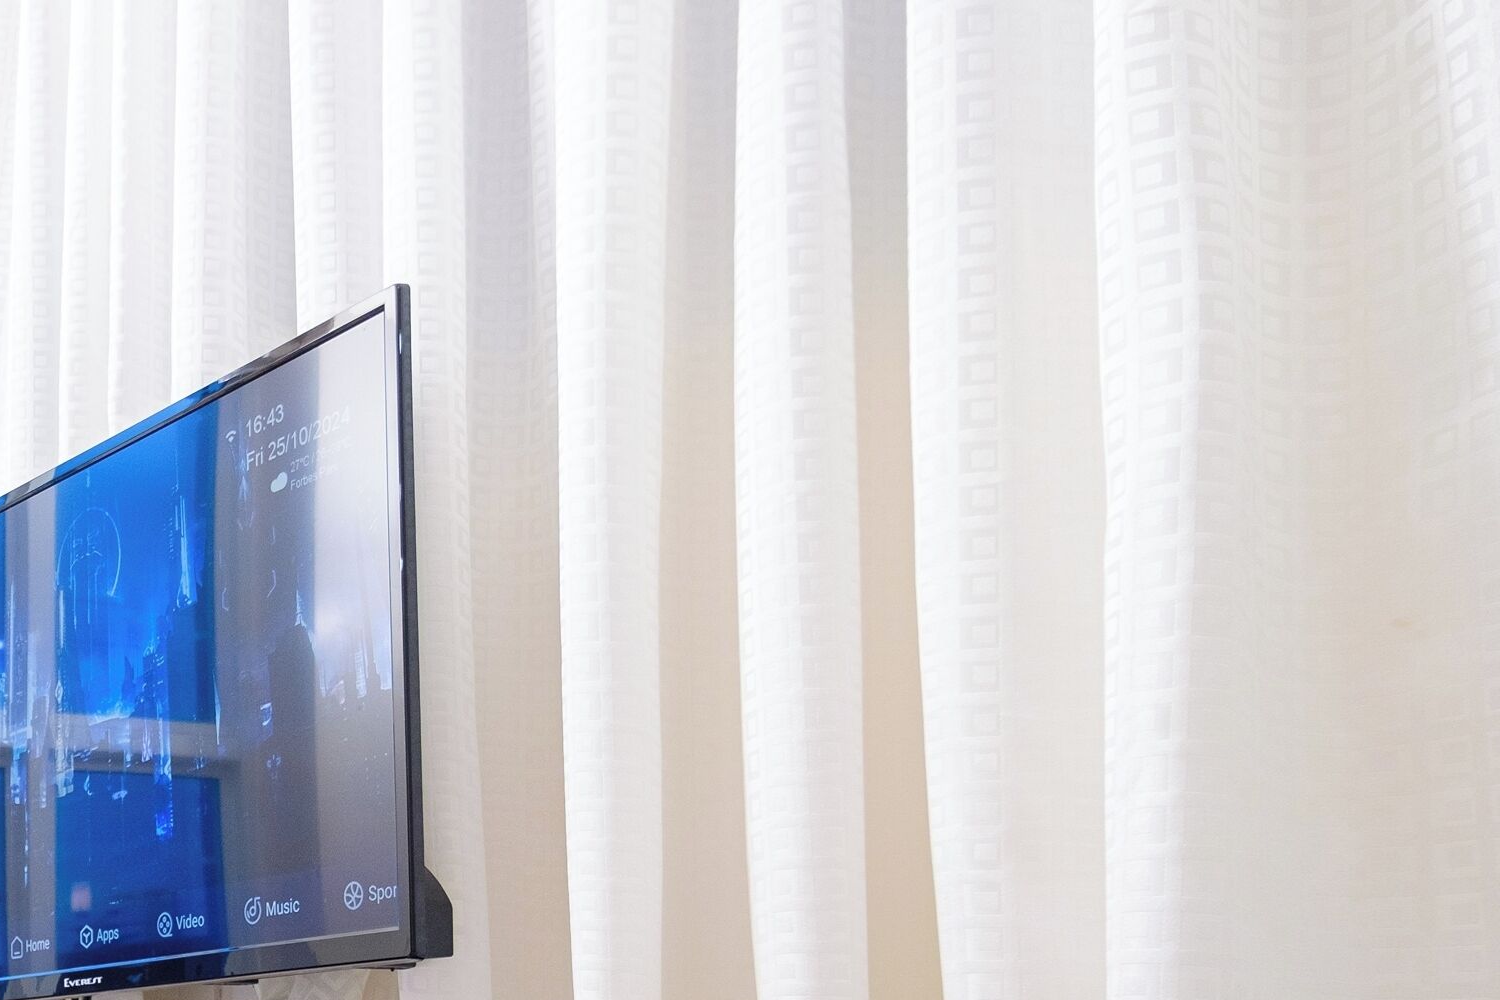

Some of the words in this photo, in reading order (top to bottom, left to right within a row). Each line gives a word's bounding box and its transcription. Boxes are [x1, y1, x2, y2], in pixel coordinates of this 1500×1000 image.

[245, 404, 284, 437] 16:43
[246, 447, 264, 471] Fri
[268, 406, 349, 461] 25/10/2024
[266, 899, 300, 917] Music
[176, 915, 205, 930] Video
[97, 926, 119, 942] Apps
[26, 937, 51, 953] Home
